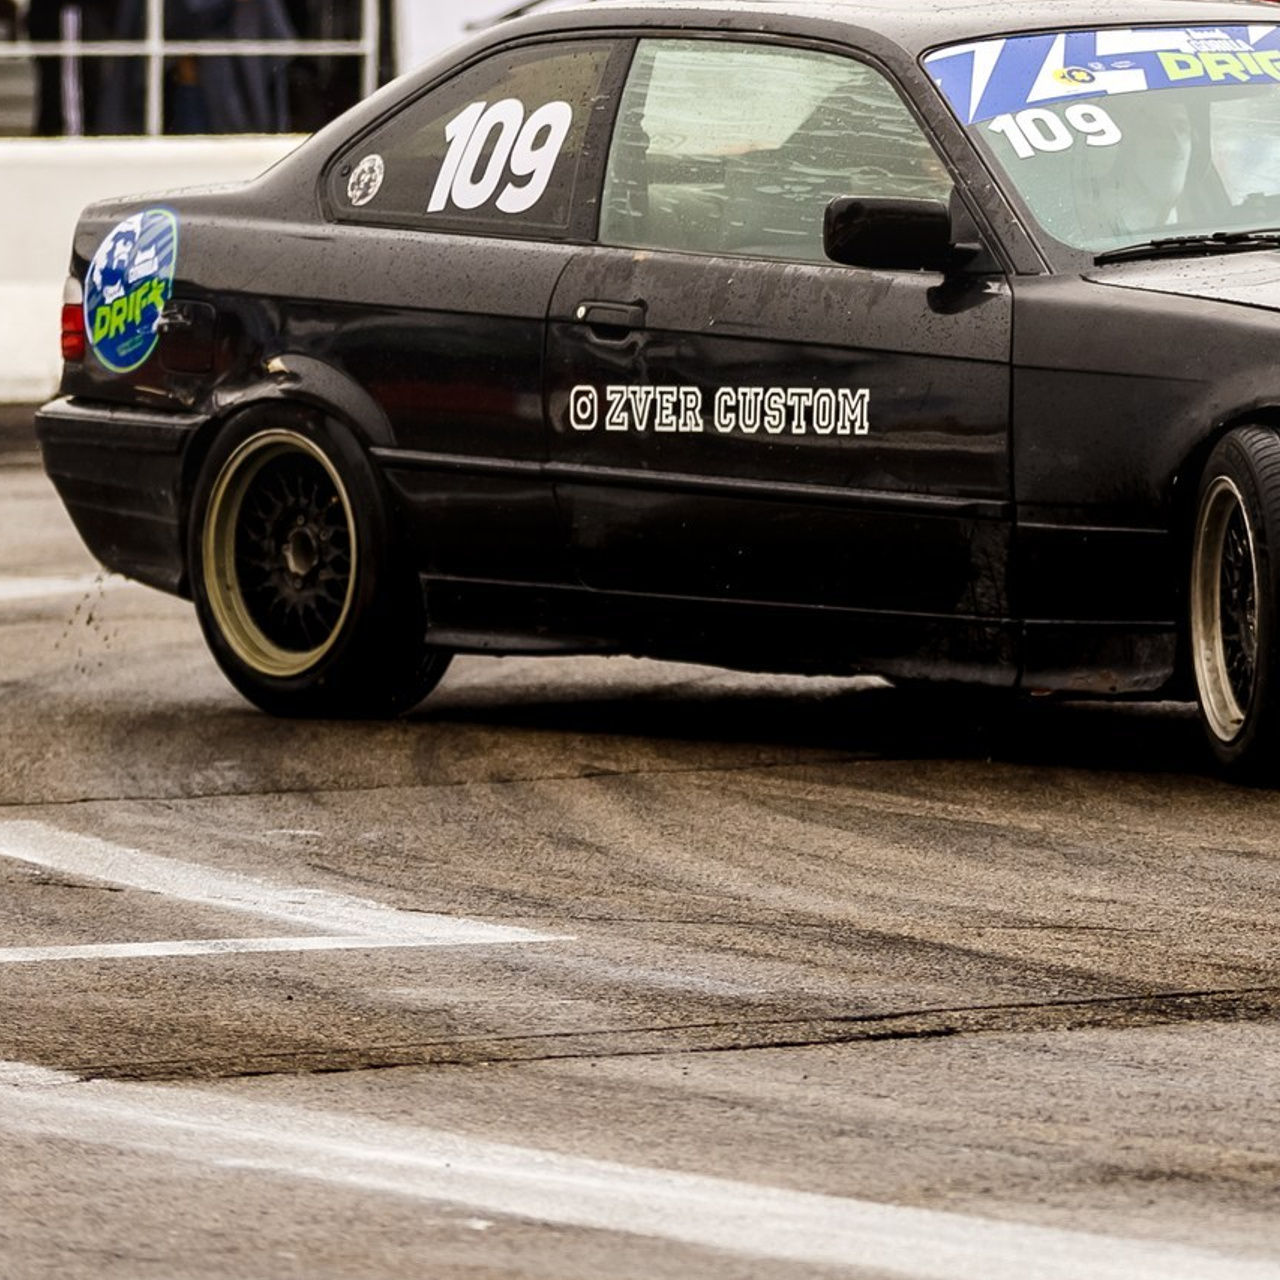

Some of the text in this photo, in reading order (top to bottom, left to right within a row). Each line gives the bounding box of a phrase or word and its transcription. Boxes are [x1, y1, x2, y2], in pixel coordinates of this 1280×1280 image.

[426, 97, 573, 214] 109
[987, 103, 1123, 160] 109
[93, 276, 166, 345] DRIFT
[605, 385, 870, 435] ZVER CUSTOM
